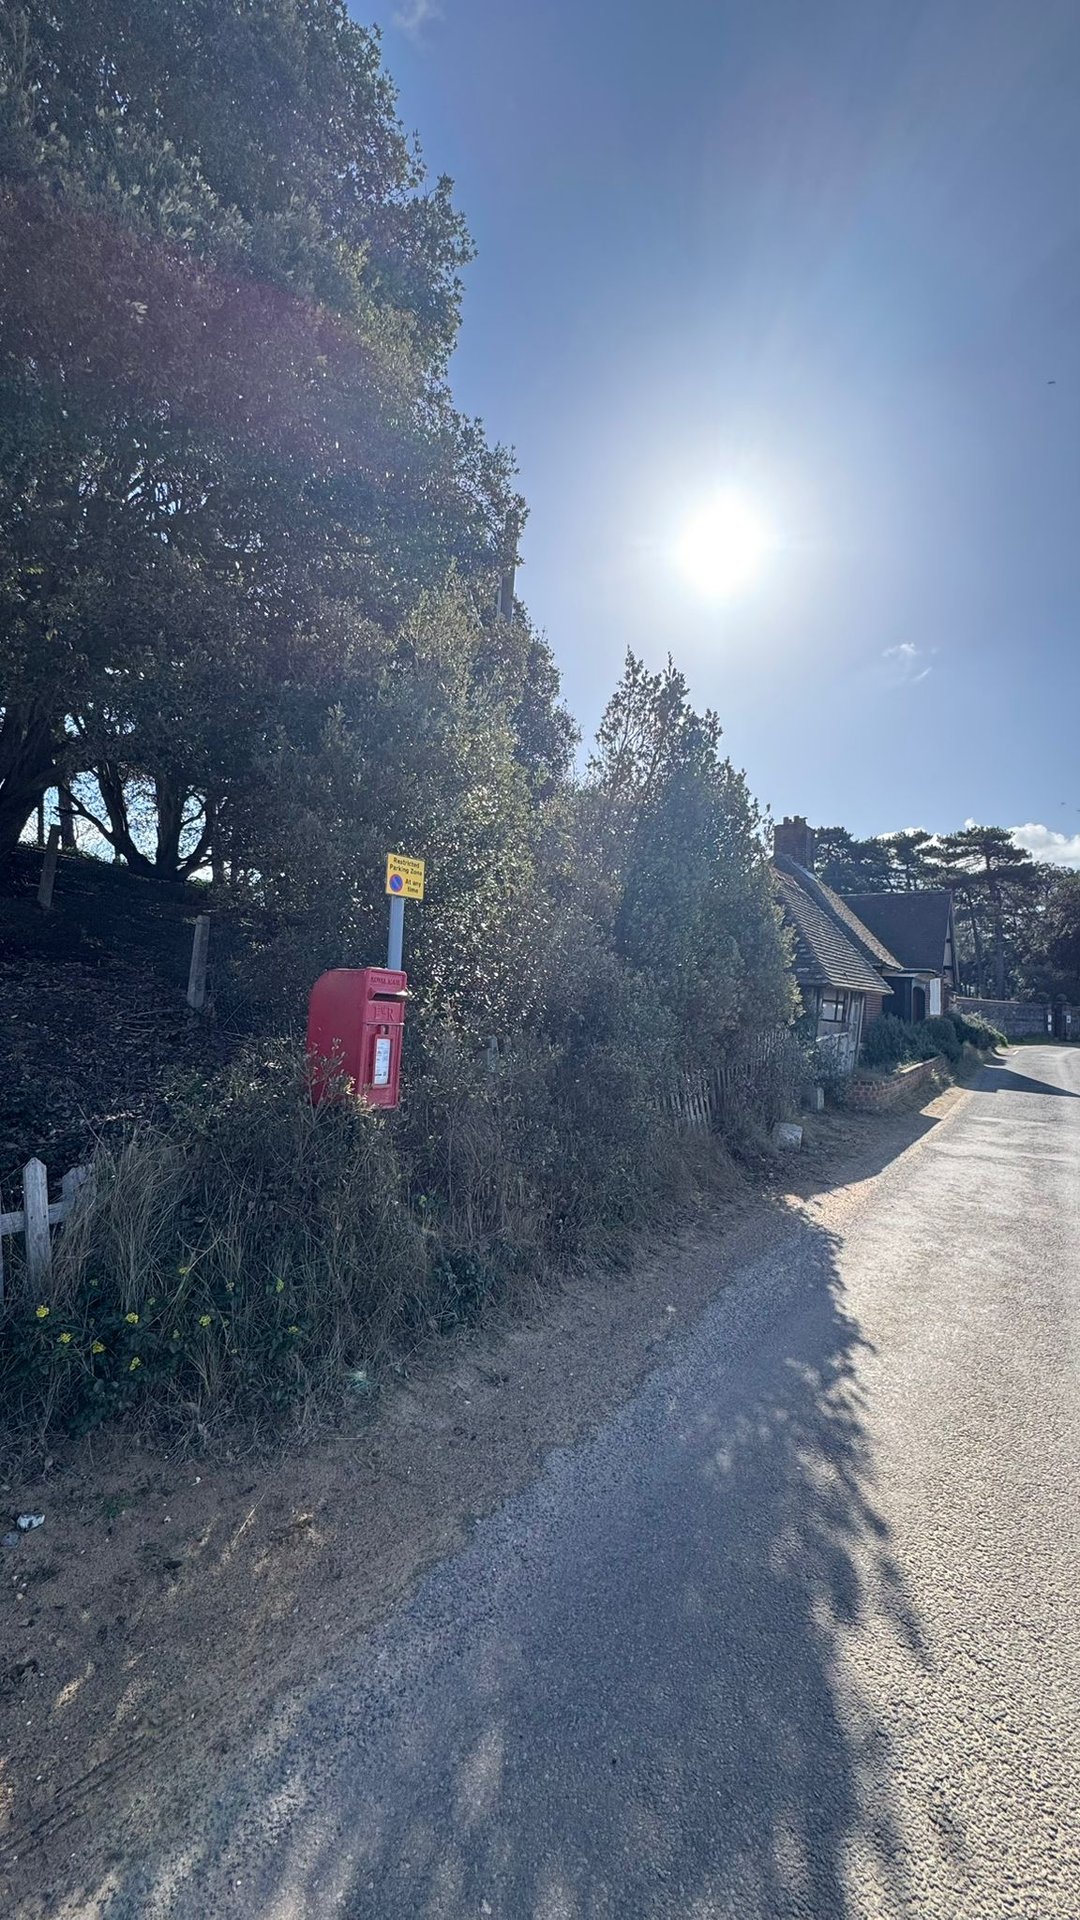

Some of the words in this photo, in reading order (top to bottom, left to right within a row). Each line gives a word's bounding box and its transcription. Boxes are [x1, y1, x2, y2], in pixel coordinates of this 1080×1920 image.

[393, 857, 420, 868] Restricted
[390, 863, 409, 874] Parking
[410, 868, 422, 876] Zone
